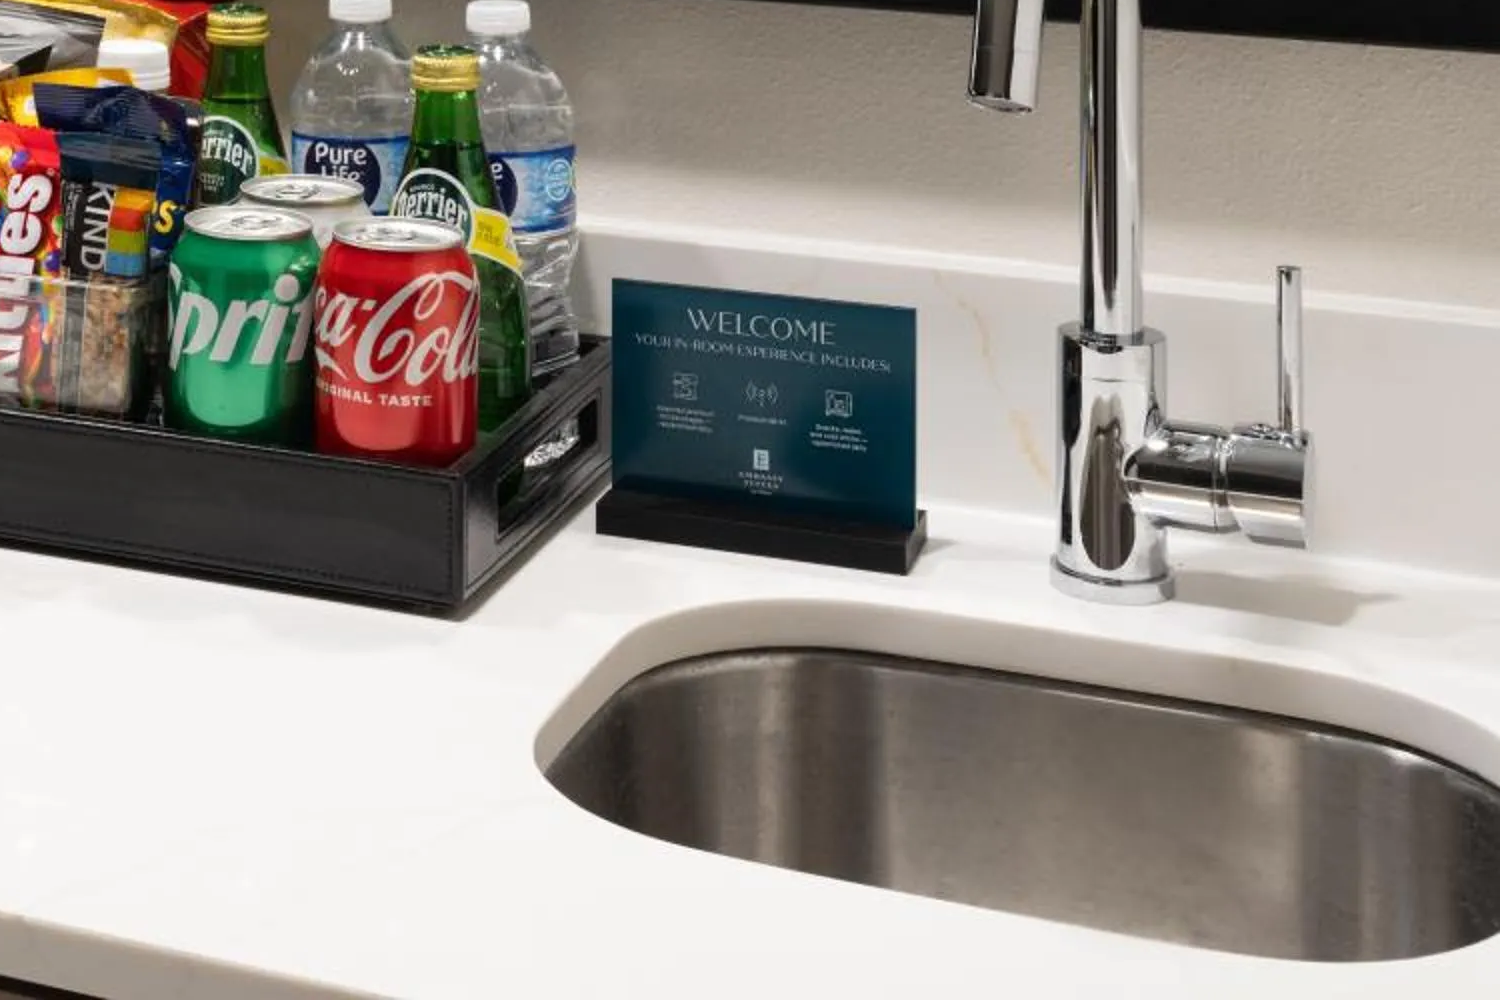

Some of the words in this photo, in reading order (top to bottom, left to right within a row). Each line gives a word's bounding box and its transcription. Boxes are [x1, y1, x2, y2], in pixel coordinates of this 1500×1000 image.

[315, 141, 368, 165] Pure
[80, 180, 115, 271] KIND
[686, 306, 837, 345] WELCOME
[634, 331, 671, 349] YOUR
[378, 394, 433, 407] TASTE
